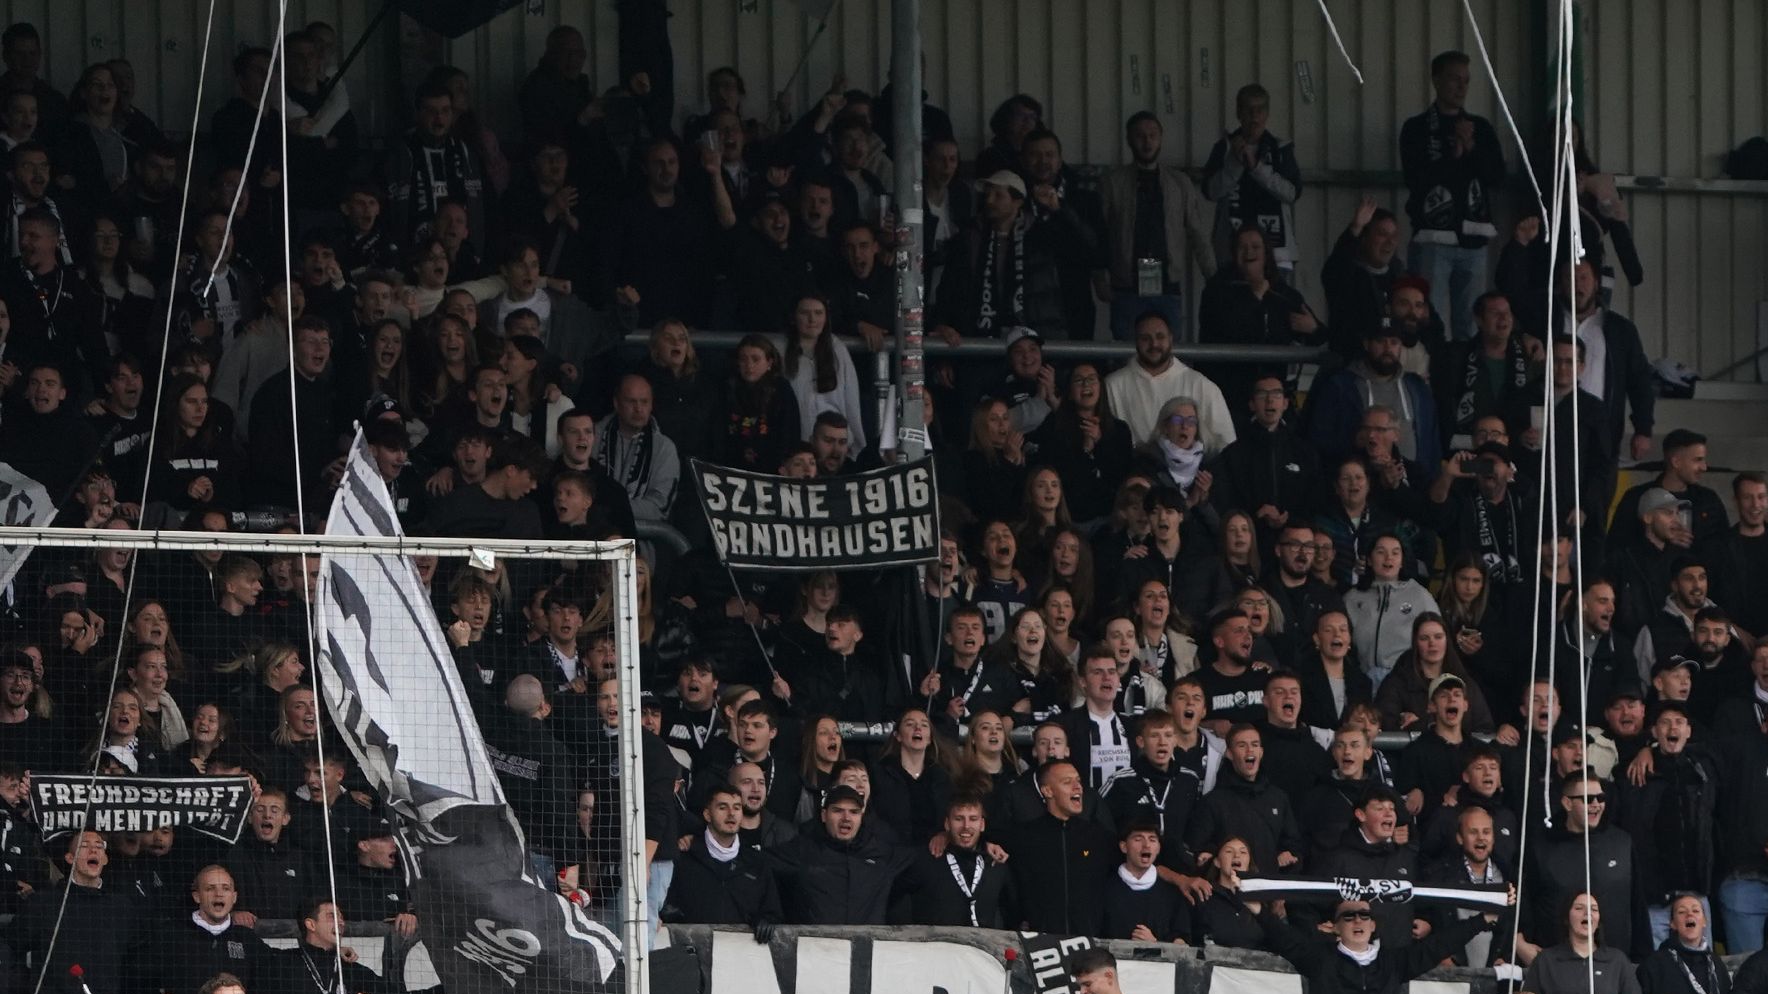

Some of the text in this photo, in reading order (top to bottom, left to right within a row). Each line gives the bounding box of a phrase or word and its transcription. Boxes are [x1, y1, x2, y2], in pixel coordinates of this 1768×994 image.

[702, 466, 930, 519] SZENE 1916
[711, 513, 934, 558] SANDHAUSEN
[38, 782, 245, 808] FREUNDSCHAFT
[43, 808, 235, 833] UND MENTALITÄT
